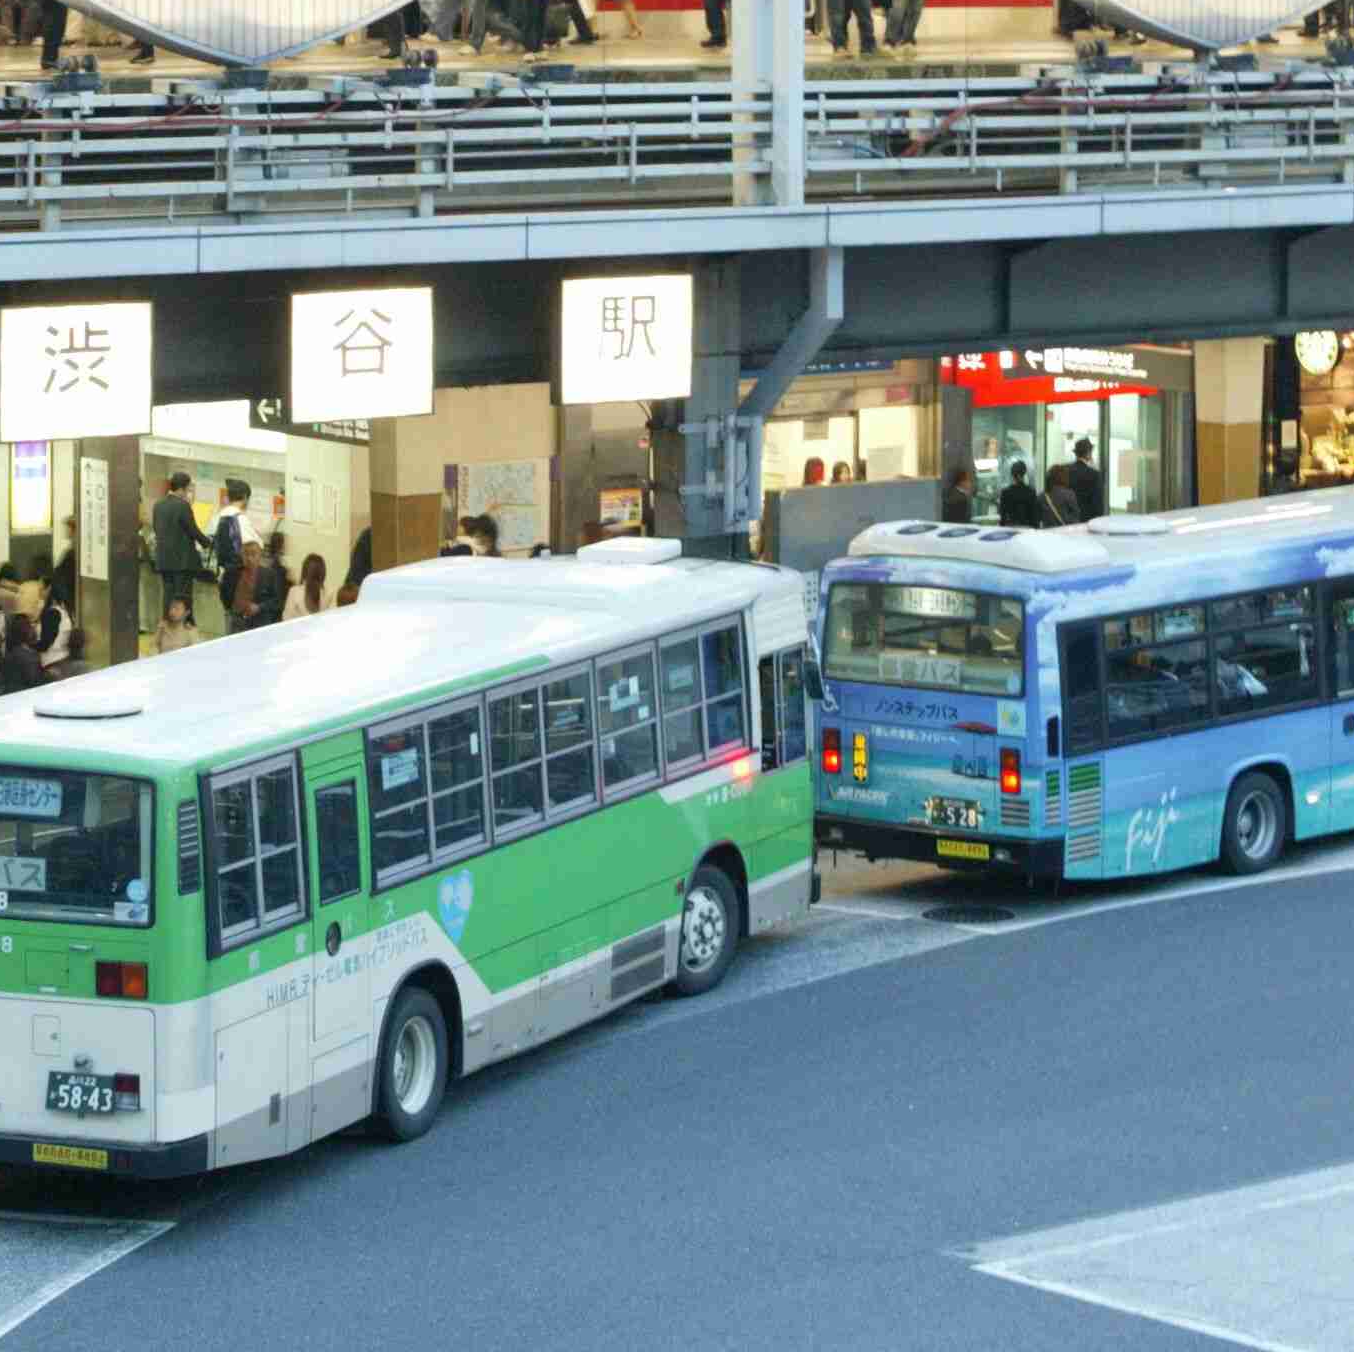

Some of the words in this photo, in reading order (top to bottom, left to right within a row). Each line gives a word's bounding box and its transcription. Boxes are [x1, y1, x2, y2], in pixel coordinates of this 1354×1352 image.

[44, 321, 111, 393] 渋
[333, 308, 393, 376] 谷
[598, 295, 656, 360] 駅
[58, 1084, 113, 1112] 58-43
